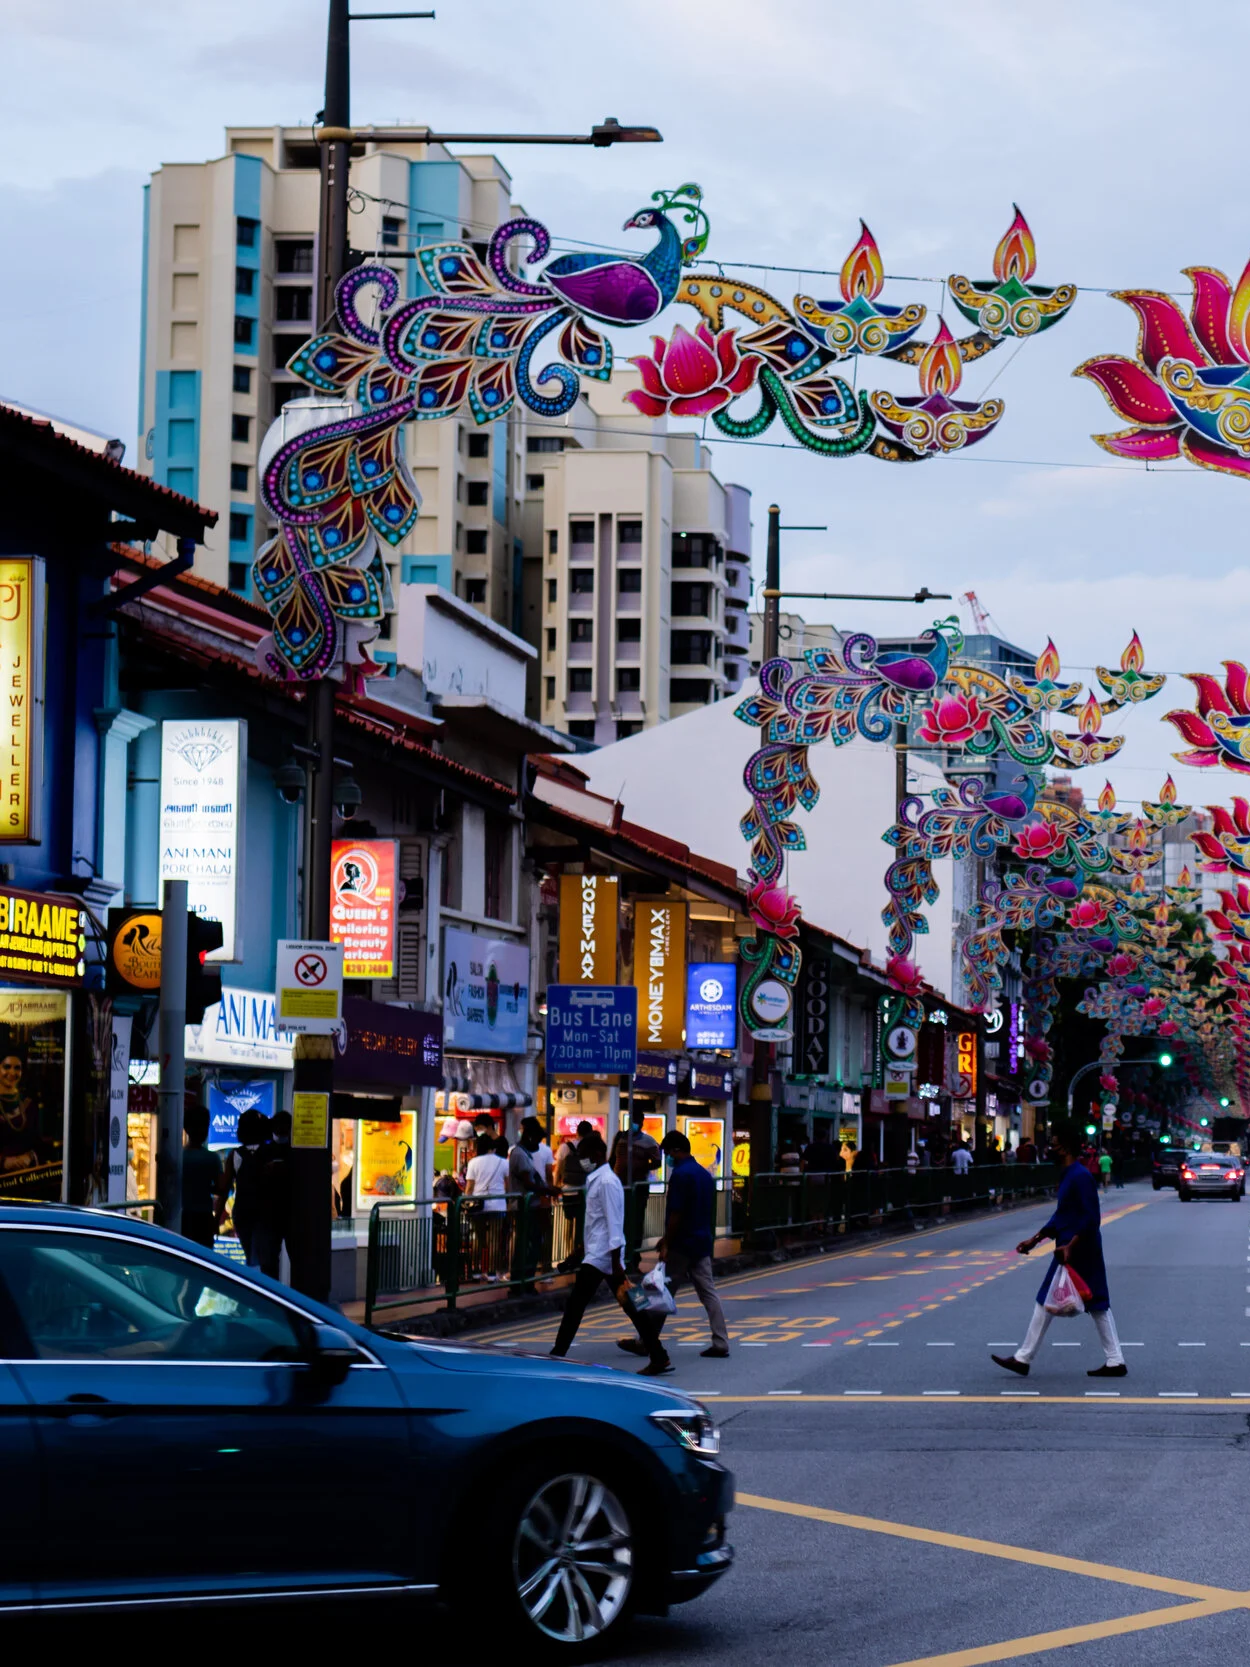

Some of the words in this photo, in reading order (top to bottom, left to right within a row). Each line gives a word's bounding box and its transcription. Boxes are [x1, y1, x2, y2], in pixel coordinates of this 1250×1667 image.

[9, 655, 23, 826] JEWELLERS
[173, 777, 198, 786] Since
[202, 777, 224, 786] 1948
[163, 848, 188, 858] ANI
[193, 848, 231, 858] MANI
[187, 904, 207, 913] OLD
[332, 923, 388, 936] Tailoring
[581, 875, 597, 979] MONEYMAX
[344, 937, 387, 950] Beauty
[344, 949, 383, 960] arlour
[690, 1003, 732, 1011] ARTHESDAM
[216, 992, 246, 1037] ANI
[551, 1007, 582, 1026] Bus
[591, 1007, 632, 1027] Lane
[807, 960, 827, 1071] GOODAY
[563, 1029, 588, 1042] Mon
[599, 1029, 619, 1043] Sat
[604, 1045, 632, 1062] 11pm
[212, 1115, 235, 1126] ANI
